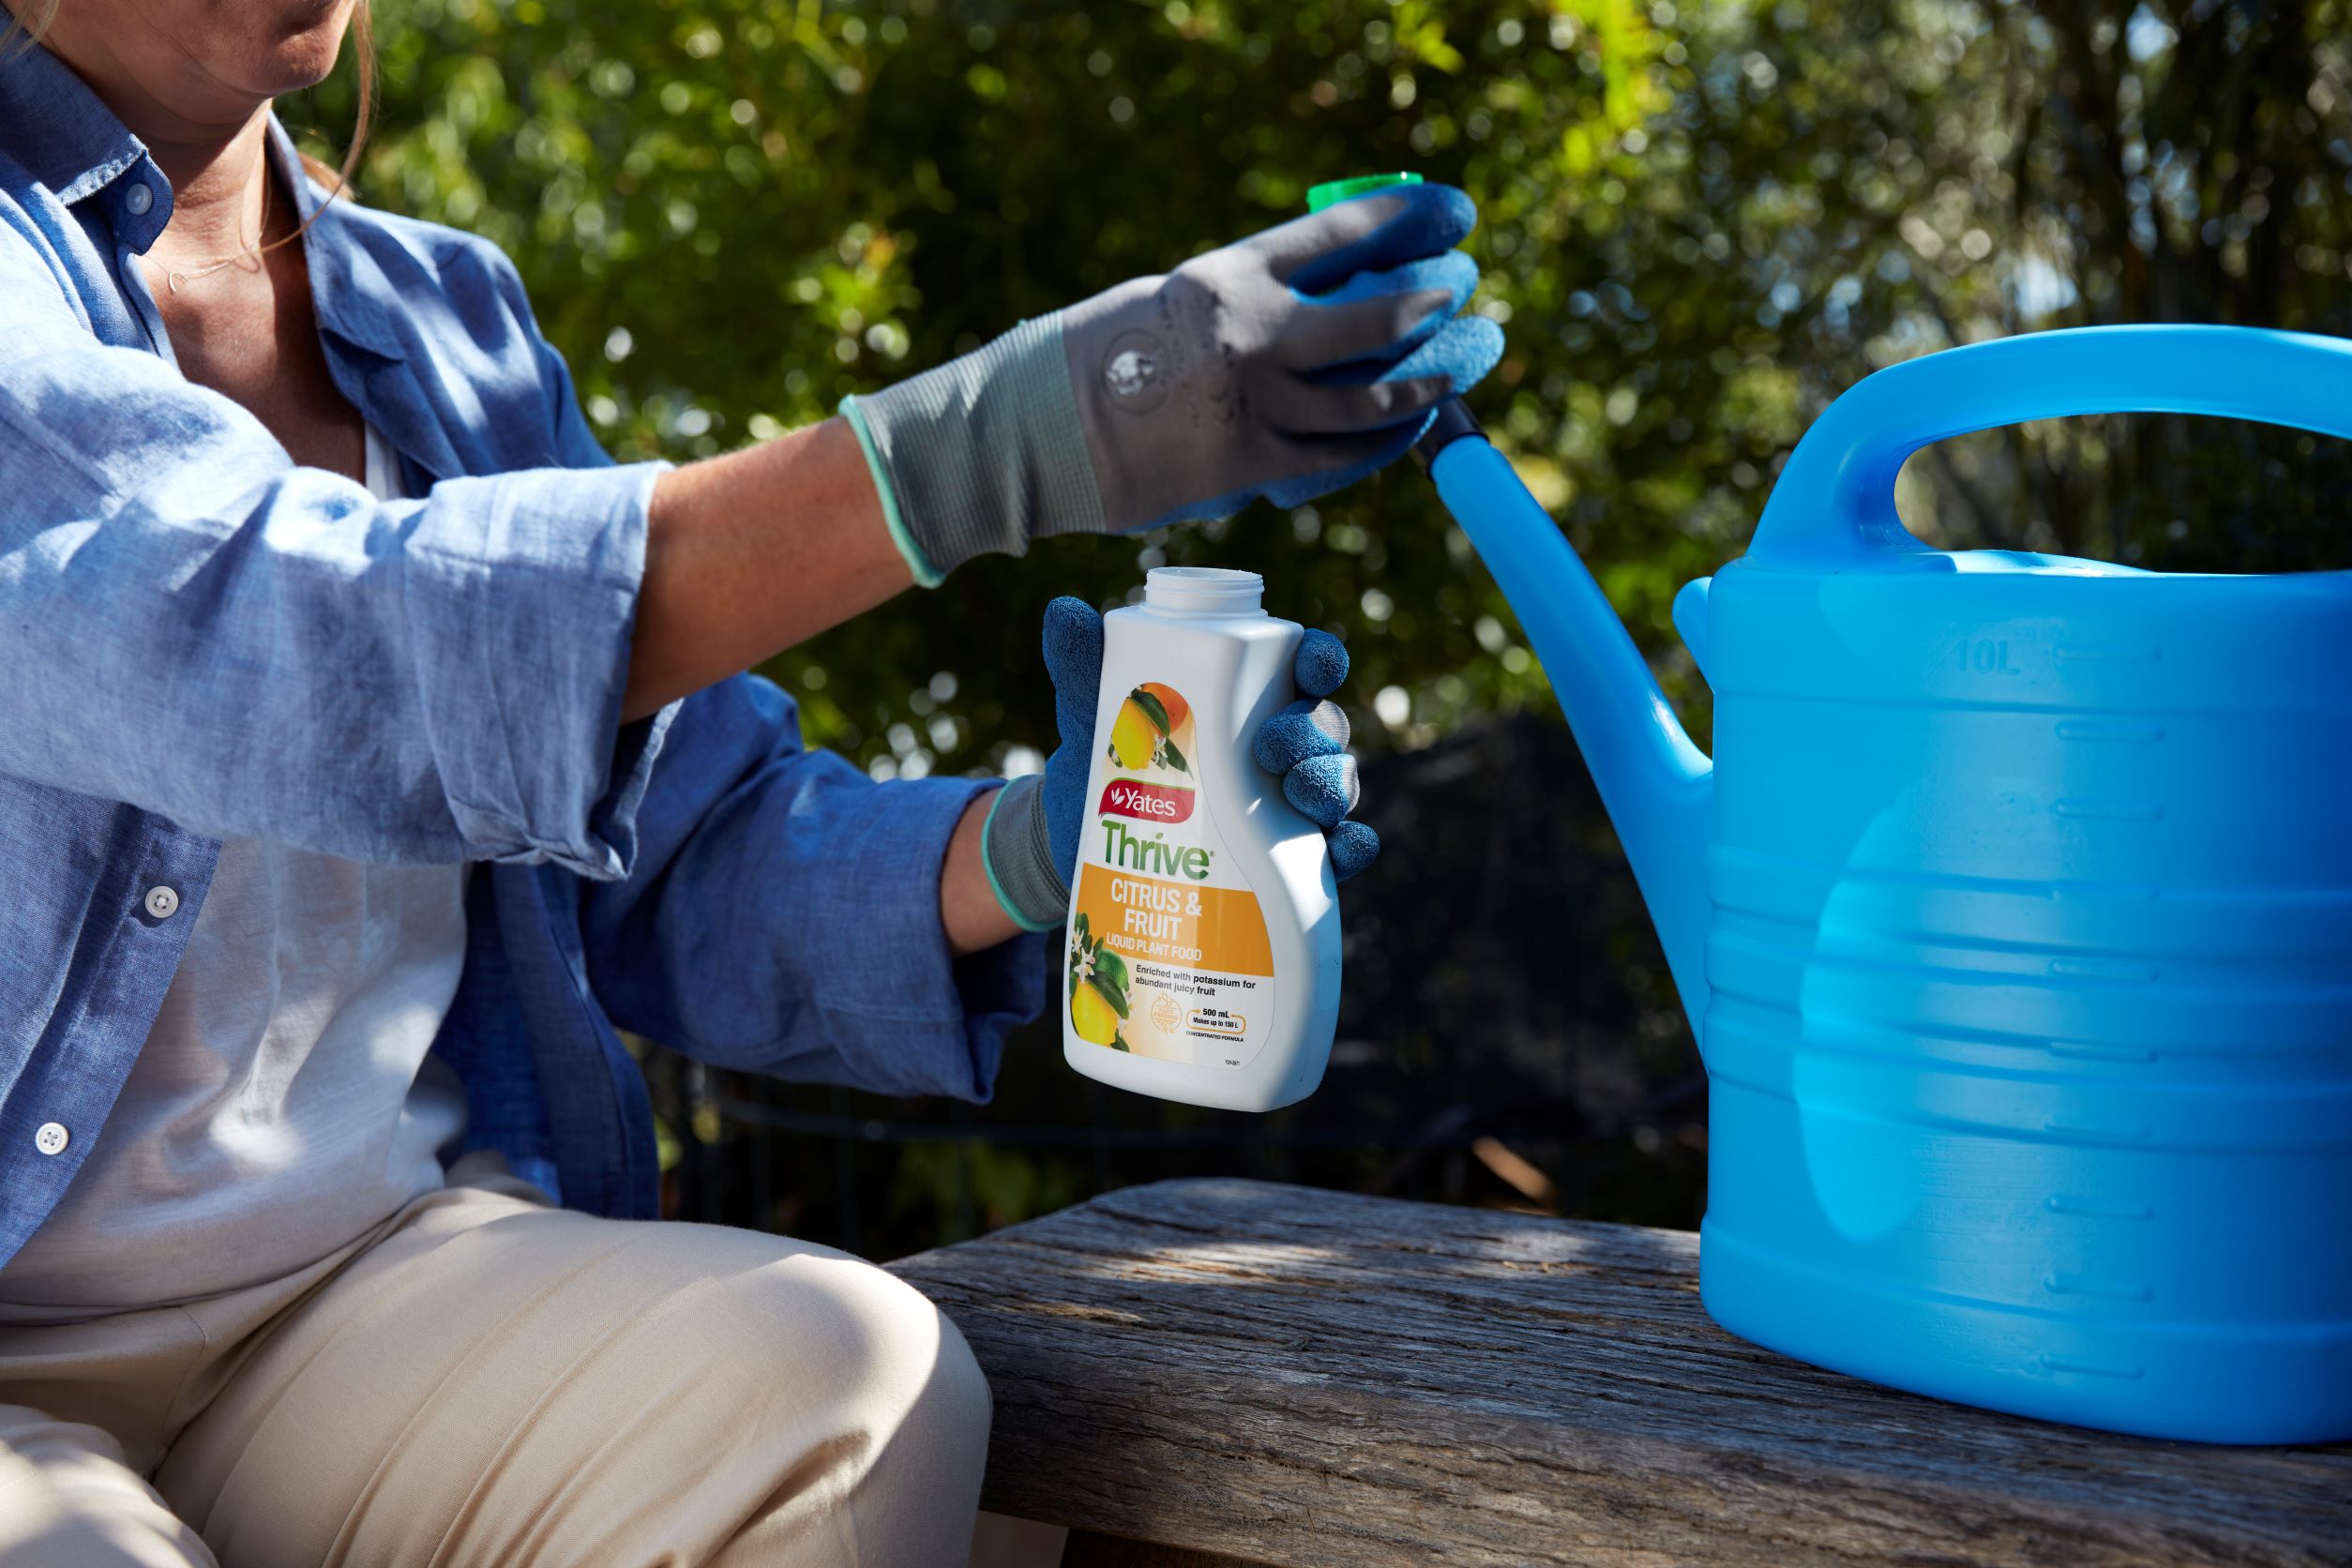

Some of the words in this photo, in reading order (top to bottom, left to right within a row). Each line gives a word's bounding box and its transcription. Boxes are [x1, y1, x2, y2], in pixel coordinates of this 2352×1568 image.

[1957, 638, 2021, 675] 10L
[1125, 788, 1176, 816] Yates
[1111, 878, 1181, 913] CITRUS
[1184, 892, 1202, 916] &
[1123, 908, 1183, 941] FRUIT
[1106, 931, 1135, 951] LIQUID
[1136, 939, 1169, 957] PLANT
[1171, 946, 1202, 961] FOOD
[1135, 976, 1171, 989] abundant
[1173, 982, 1195, 995] juicy
[1197, 986, 1215, 996] fruit
[1136, 964, 1170, 978] Enriched
[1173, 972, 1191, 982] with
[1193, 975, 1240, 988] potassium
[1243, 979, 1257, 989] for
[1193, 1017, 1210, 1025] Makes
[1202, 1008, 1216, 1017] 500
[1218, 1010, 1229, 1018] mL
[1185, 1030, 1221, 1040] CONCENTRATED
